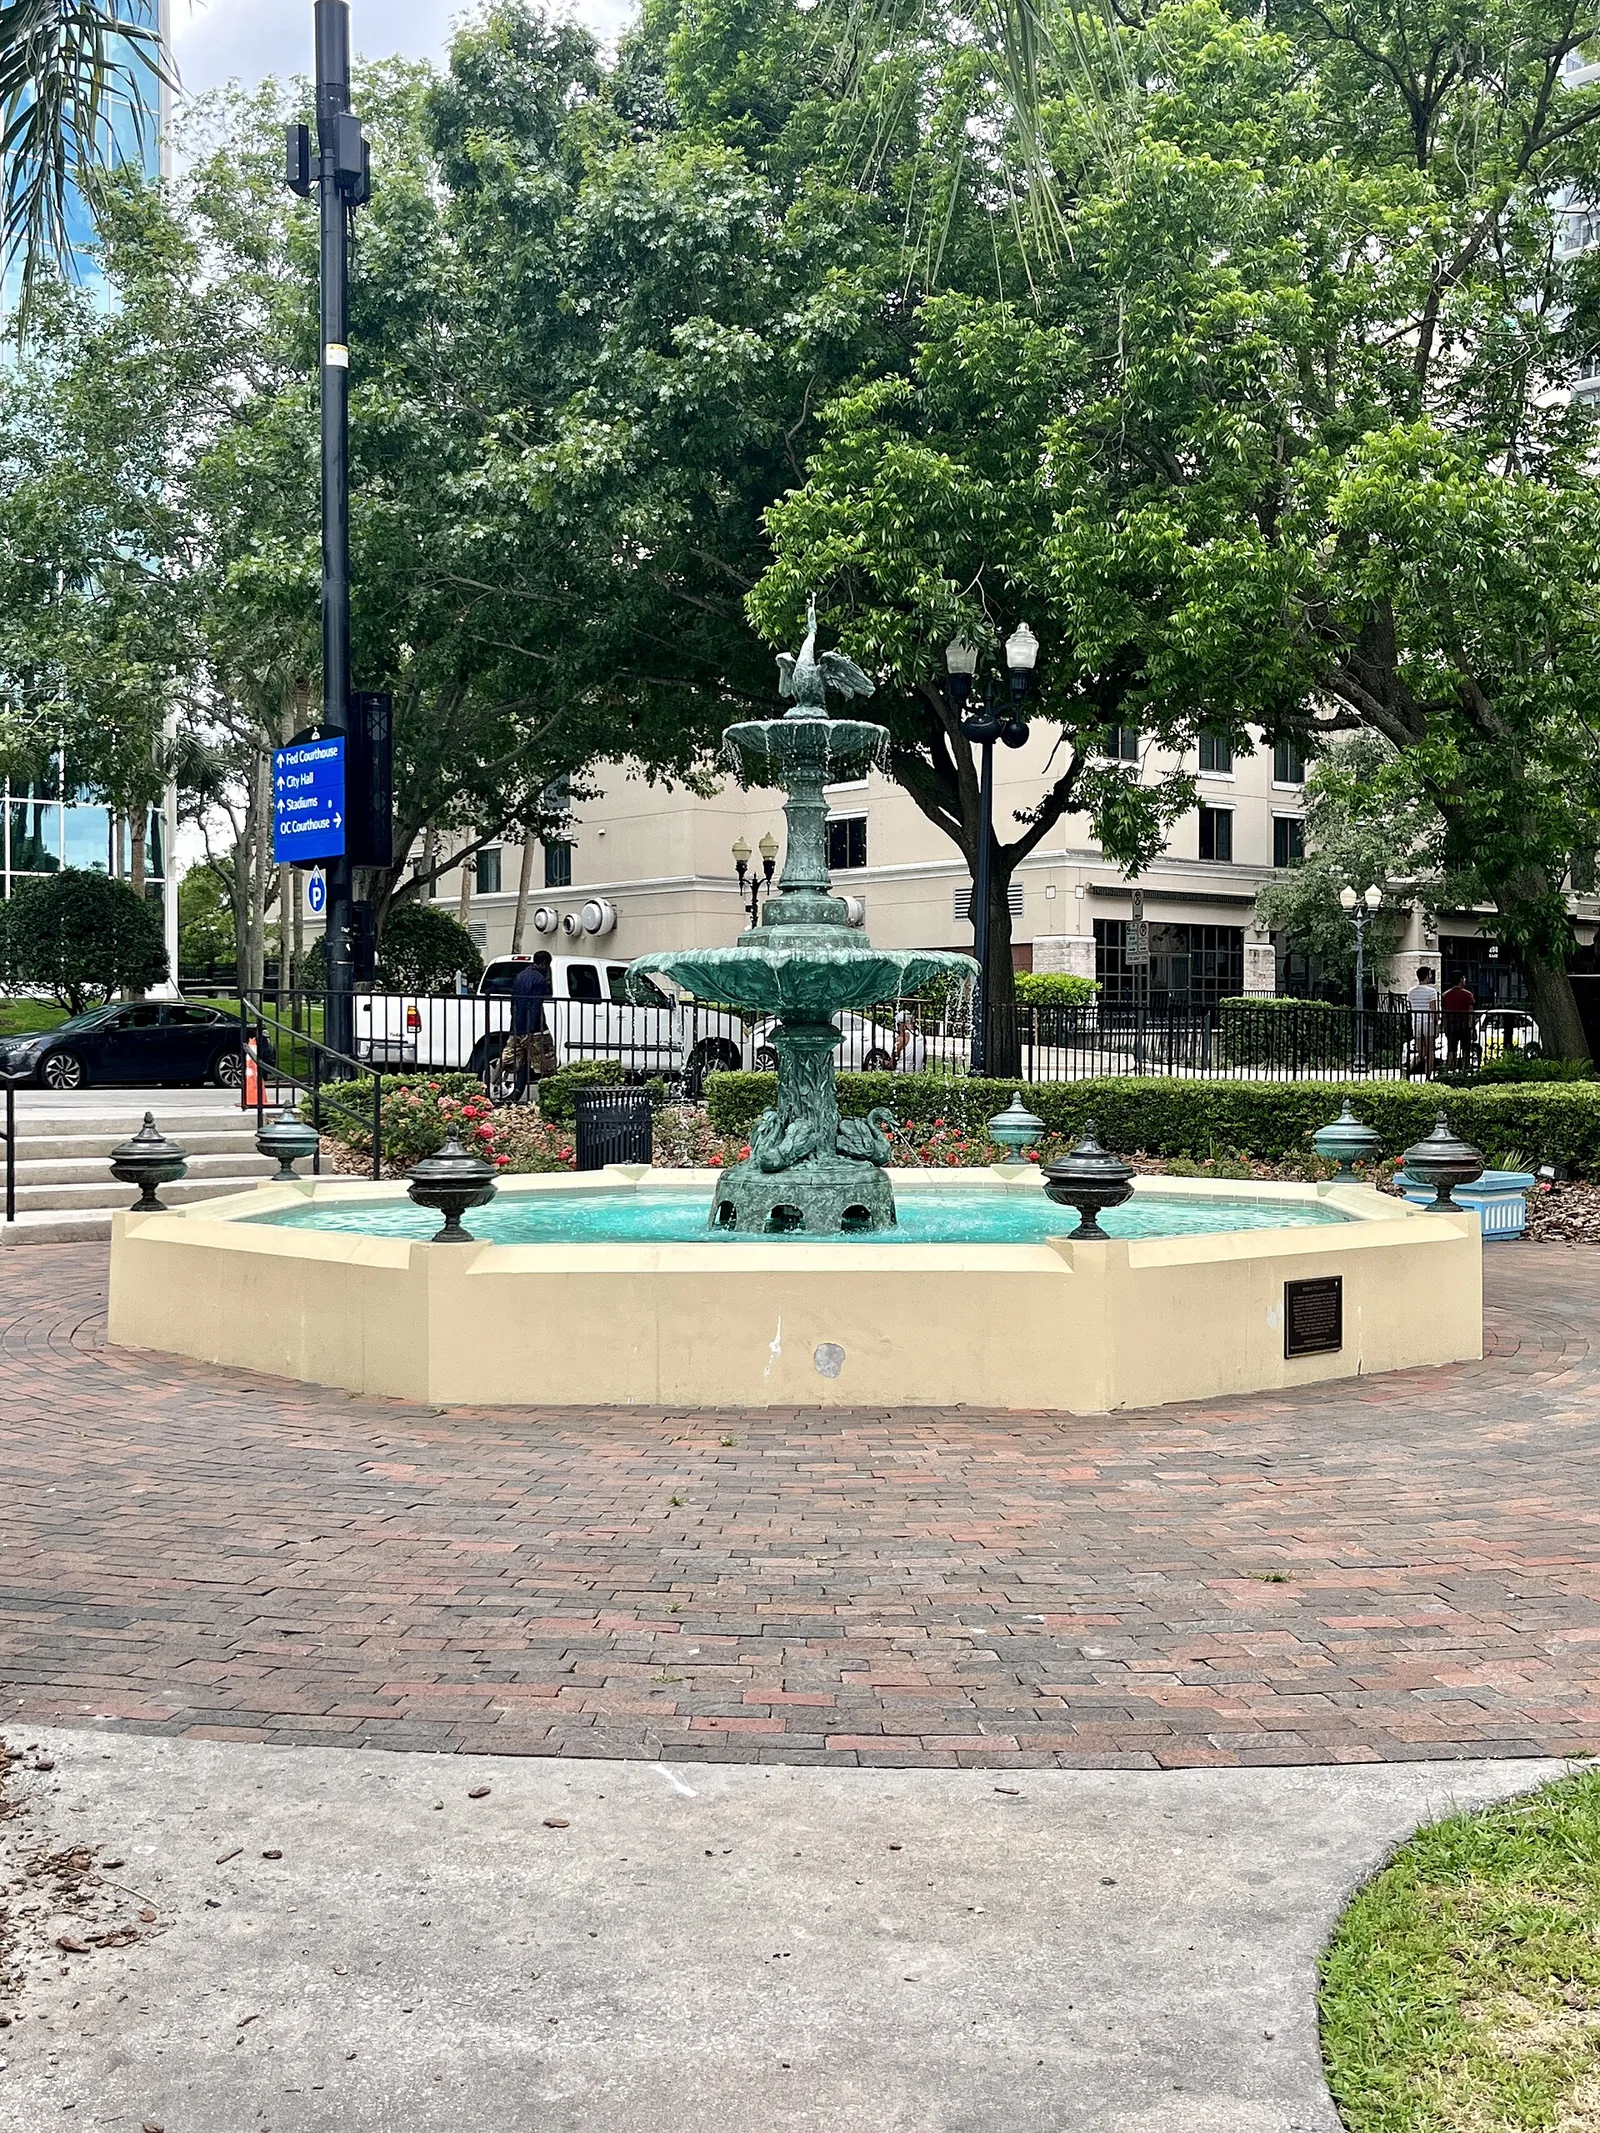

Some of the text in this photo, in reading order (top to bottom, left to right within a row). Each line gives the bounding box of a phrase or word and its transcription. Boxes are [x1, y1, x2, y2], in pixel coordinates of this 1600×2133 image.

[286, 747, 338, 765] Fed Courthouse
[286, 772, 314, 789] City Hall
[286, 797, 318, 811] Stadiums
[280, 819, 330, 834] OC Courthouse
[312, 887, 321, 907] P
